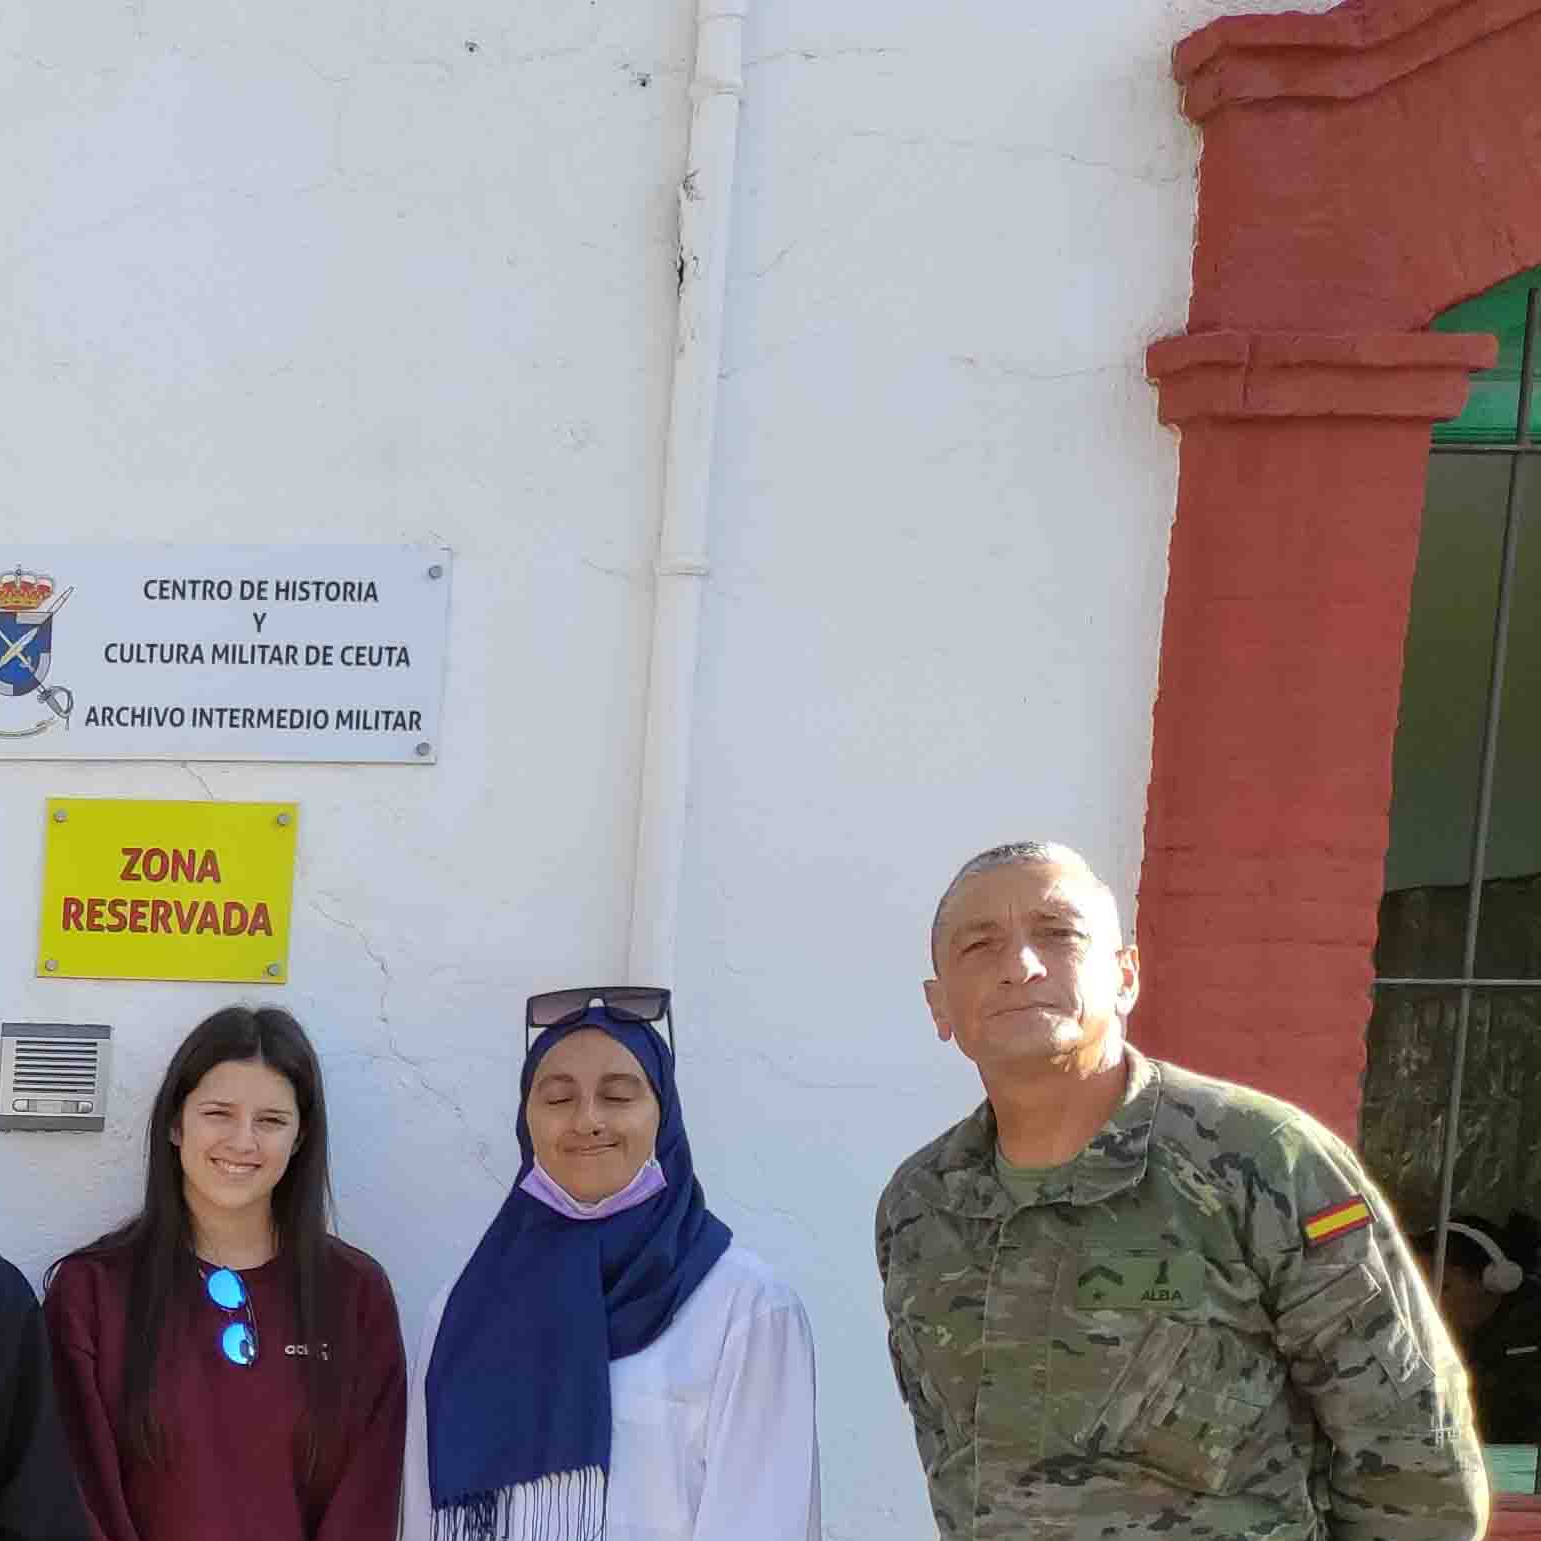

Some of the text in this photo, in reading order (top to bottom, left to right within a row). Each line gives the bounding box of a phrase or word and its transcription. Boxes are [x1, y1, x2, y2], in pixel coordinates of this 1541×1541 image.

[143, 579, 379, 603] CENTRO DE HISTORIA
[252, 612, 267, 633] Y
[104, 642, 411, 667] CULTURA MILITAR DE CEUTA
[84, 706, 422, 732] ARCHIVO INTERMEDIO MILITAR
[120, 847, 222, 883] ZONA
[62, 897, 273, 937] RESERVADA
